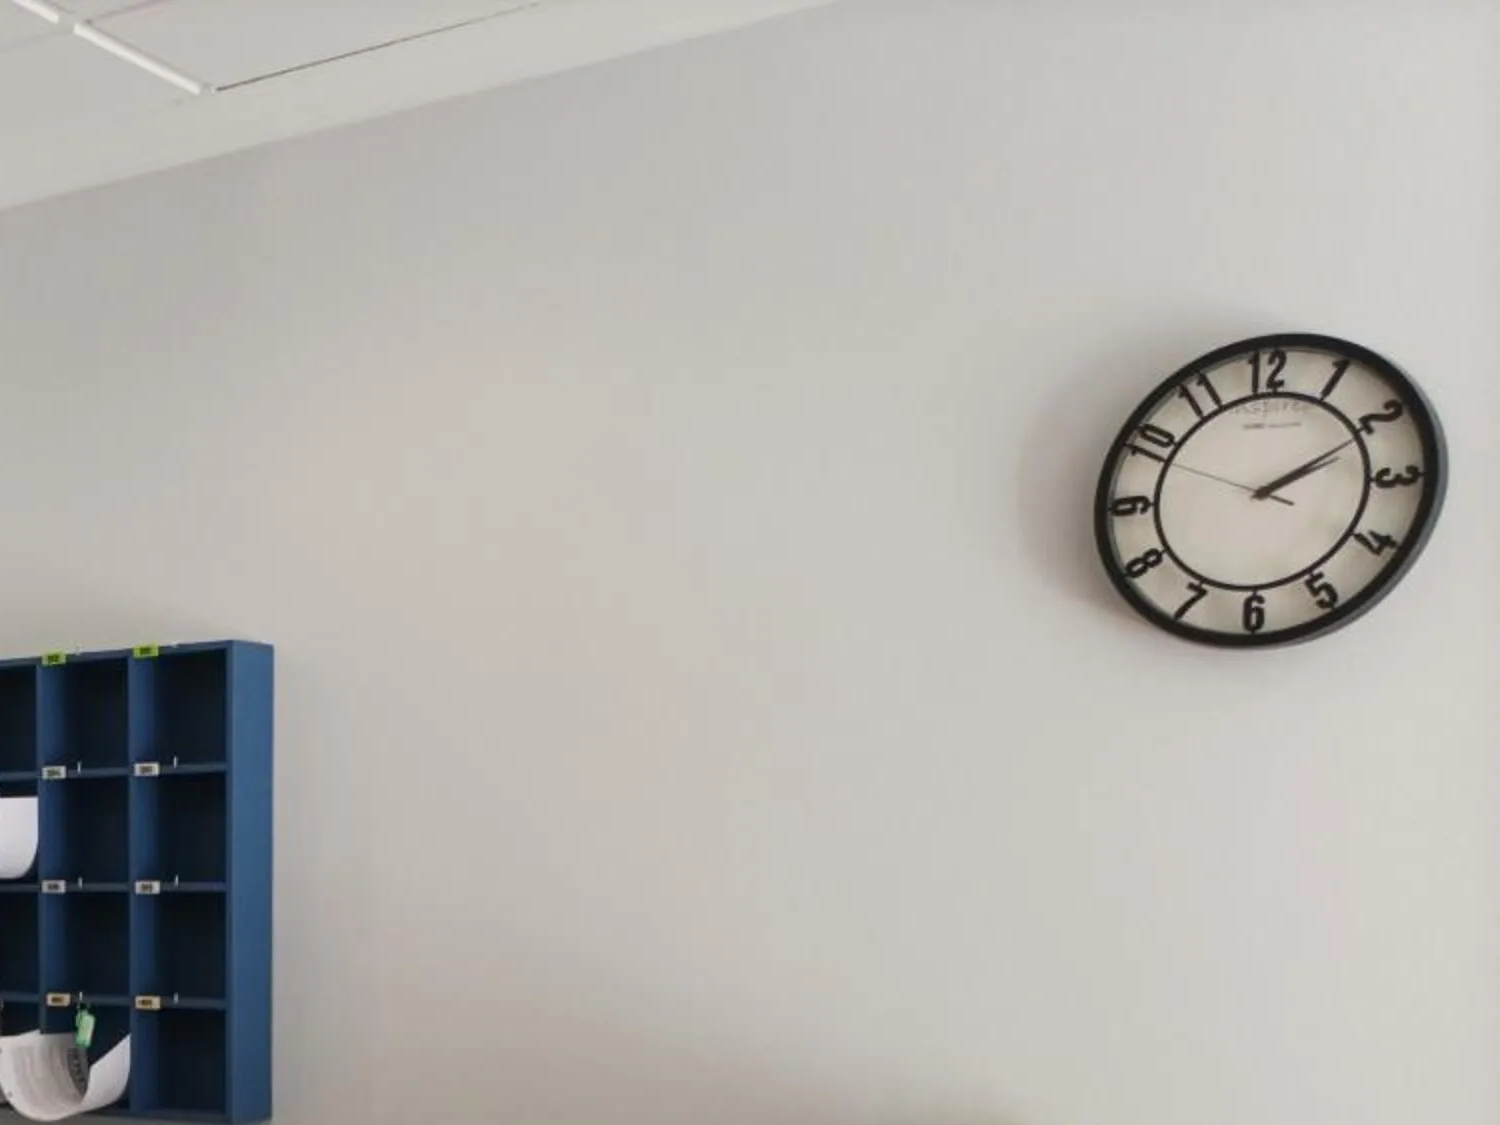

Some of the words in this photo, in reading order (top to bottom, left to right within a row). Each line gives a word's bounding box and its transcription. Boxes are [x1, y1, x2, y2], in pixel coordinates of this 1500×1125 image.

[1249, 350, 1287, 393] 12
[1320, 359, 1350, 400] 1
[1179, 373, 1222, 416] 11
[1358, 400, 1404, 434] 2
[1125, 424, 1176, 462] 10
[1372, 464, 1422, 489] 3
[1109, 495, 1151, 517] 9
[1353, 530, 1398, 555] 4
[1124, 548, 1163, 578] 8
[1174, 581, 1208, 620] 7
[1304, 572, 1338, 609] 5
[1243, 594, 1265, 632] 6
